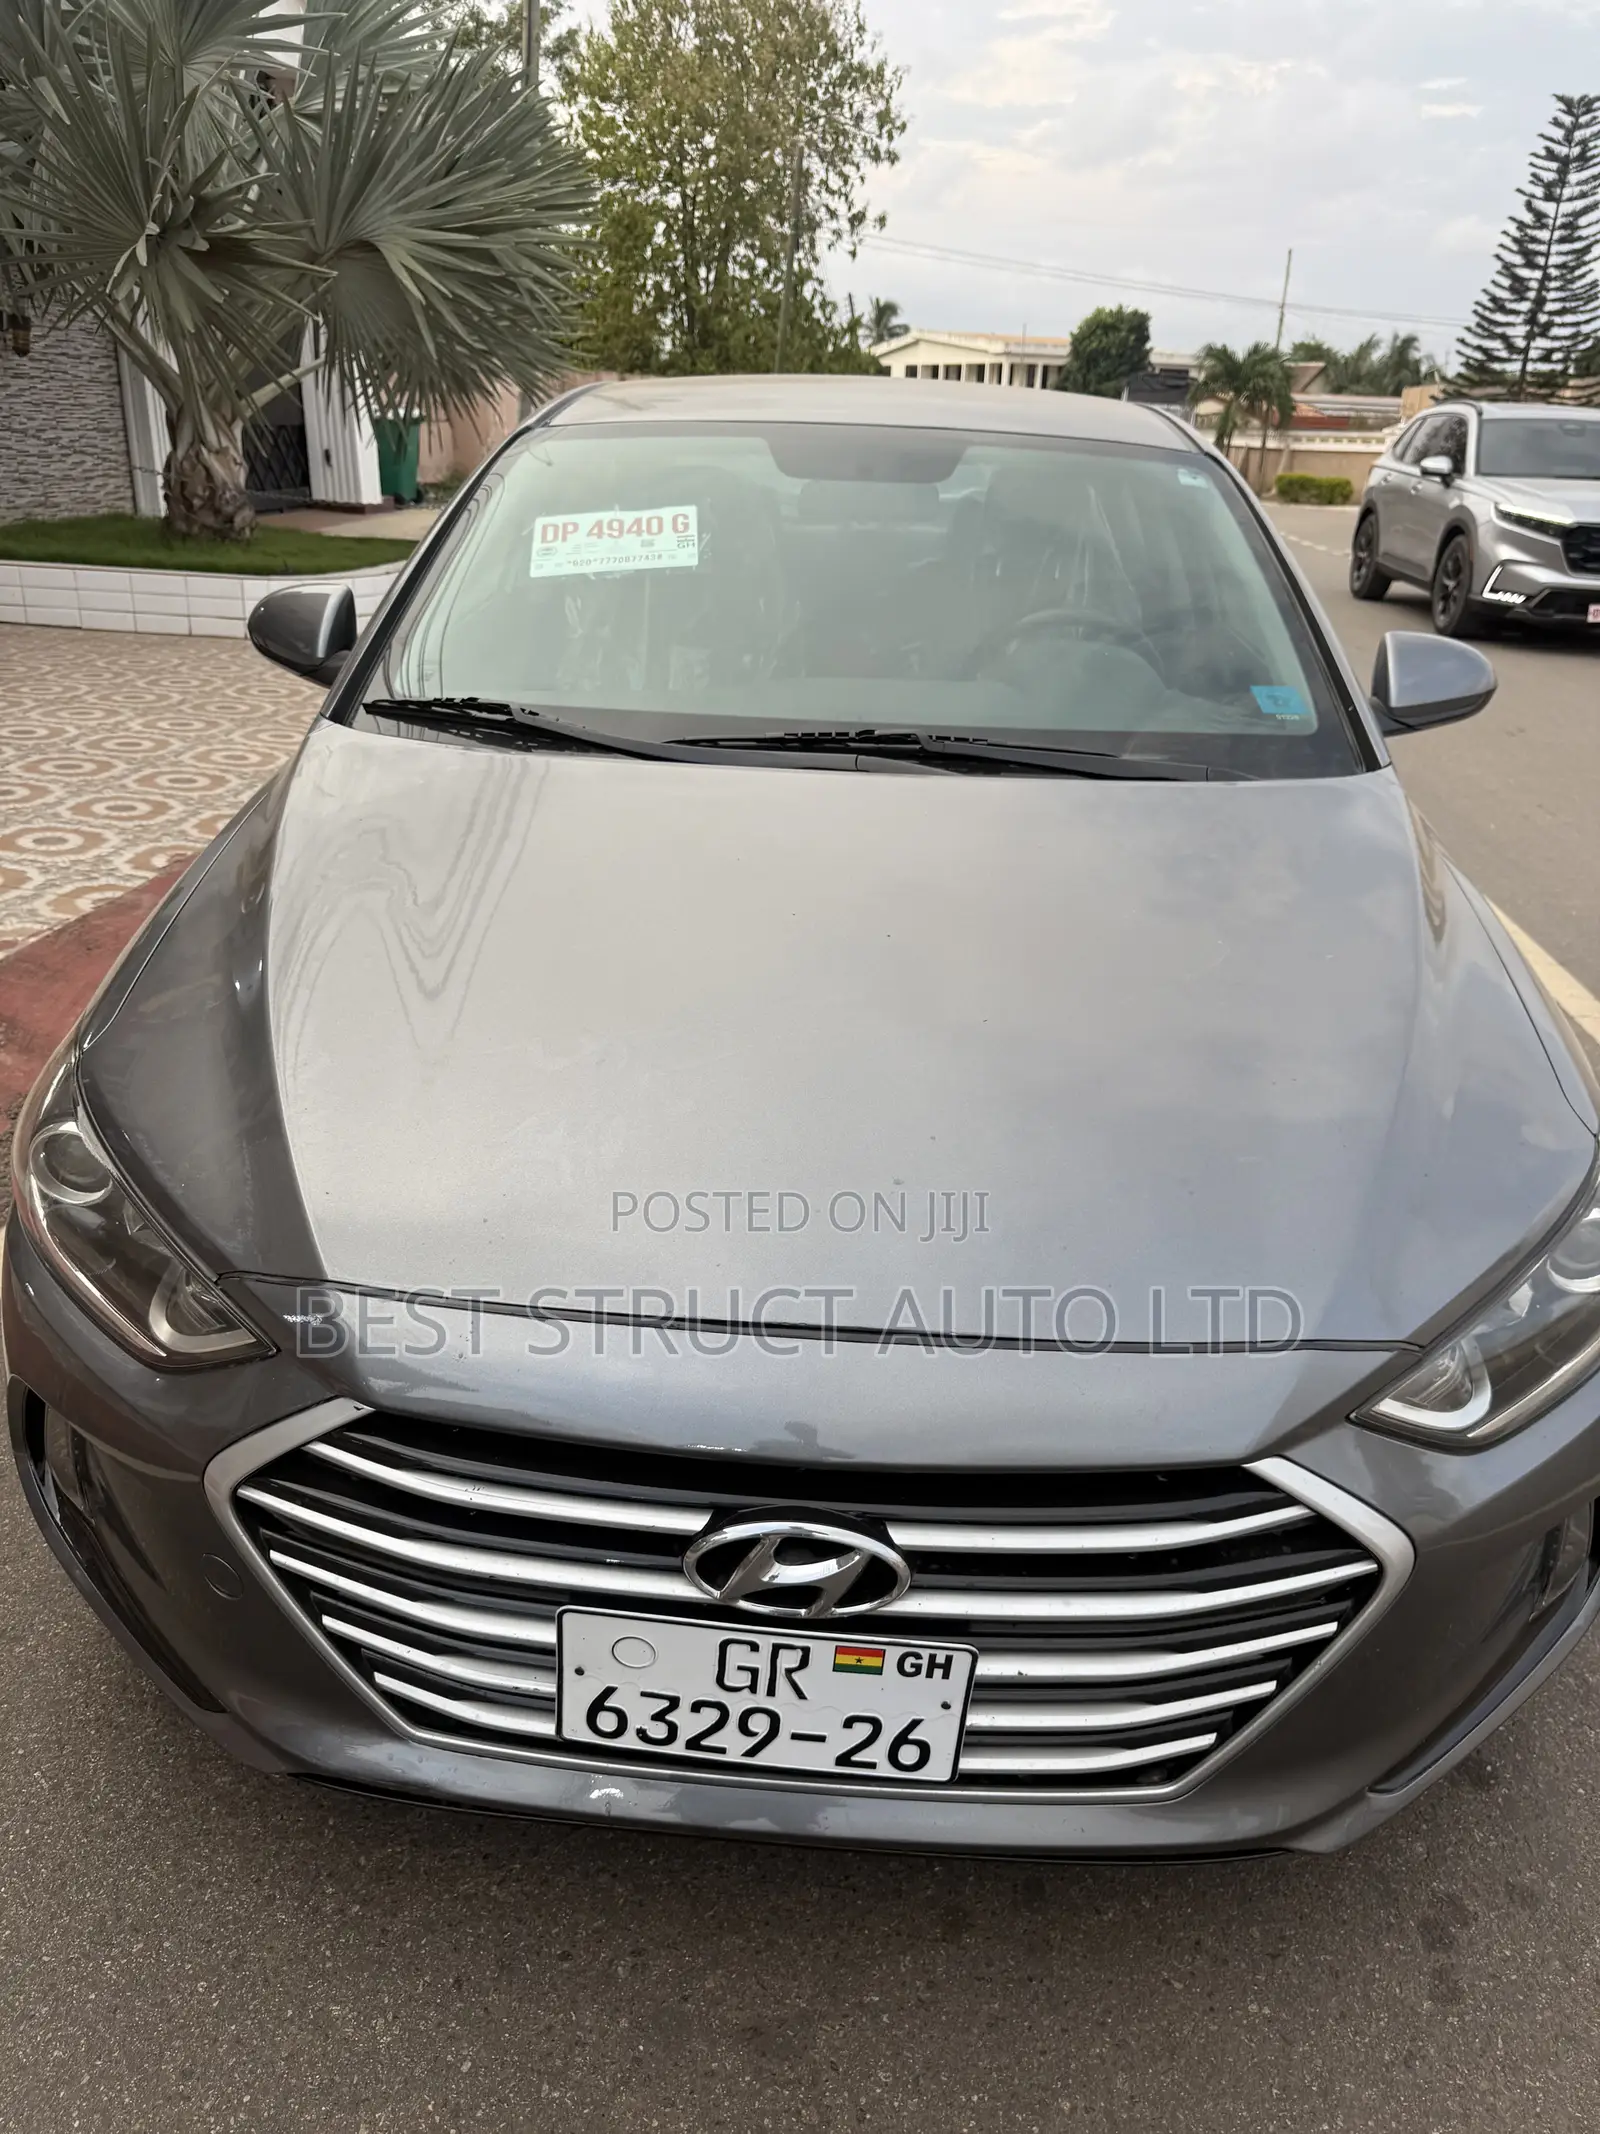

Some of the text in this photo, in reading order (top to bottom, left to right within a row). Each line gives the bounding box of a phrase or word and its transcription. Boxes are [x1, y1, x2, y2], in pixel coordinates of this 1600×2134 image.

[540, 513, 690, 544] DP 4940 G
[716, 1637, 953, 1700] GR GH
[585, 1685, 931, 1772] 6329-26
